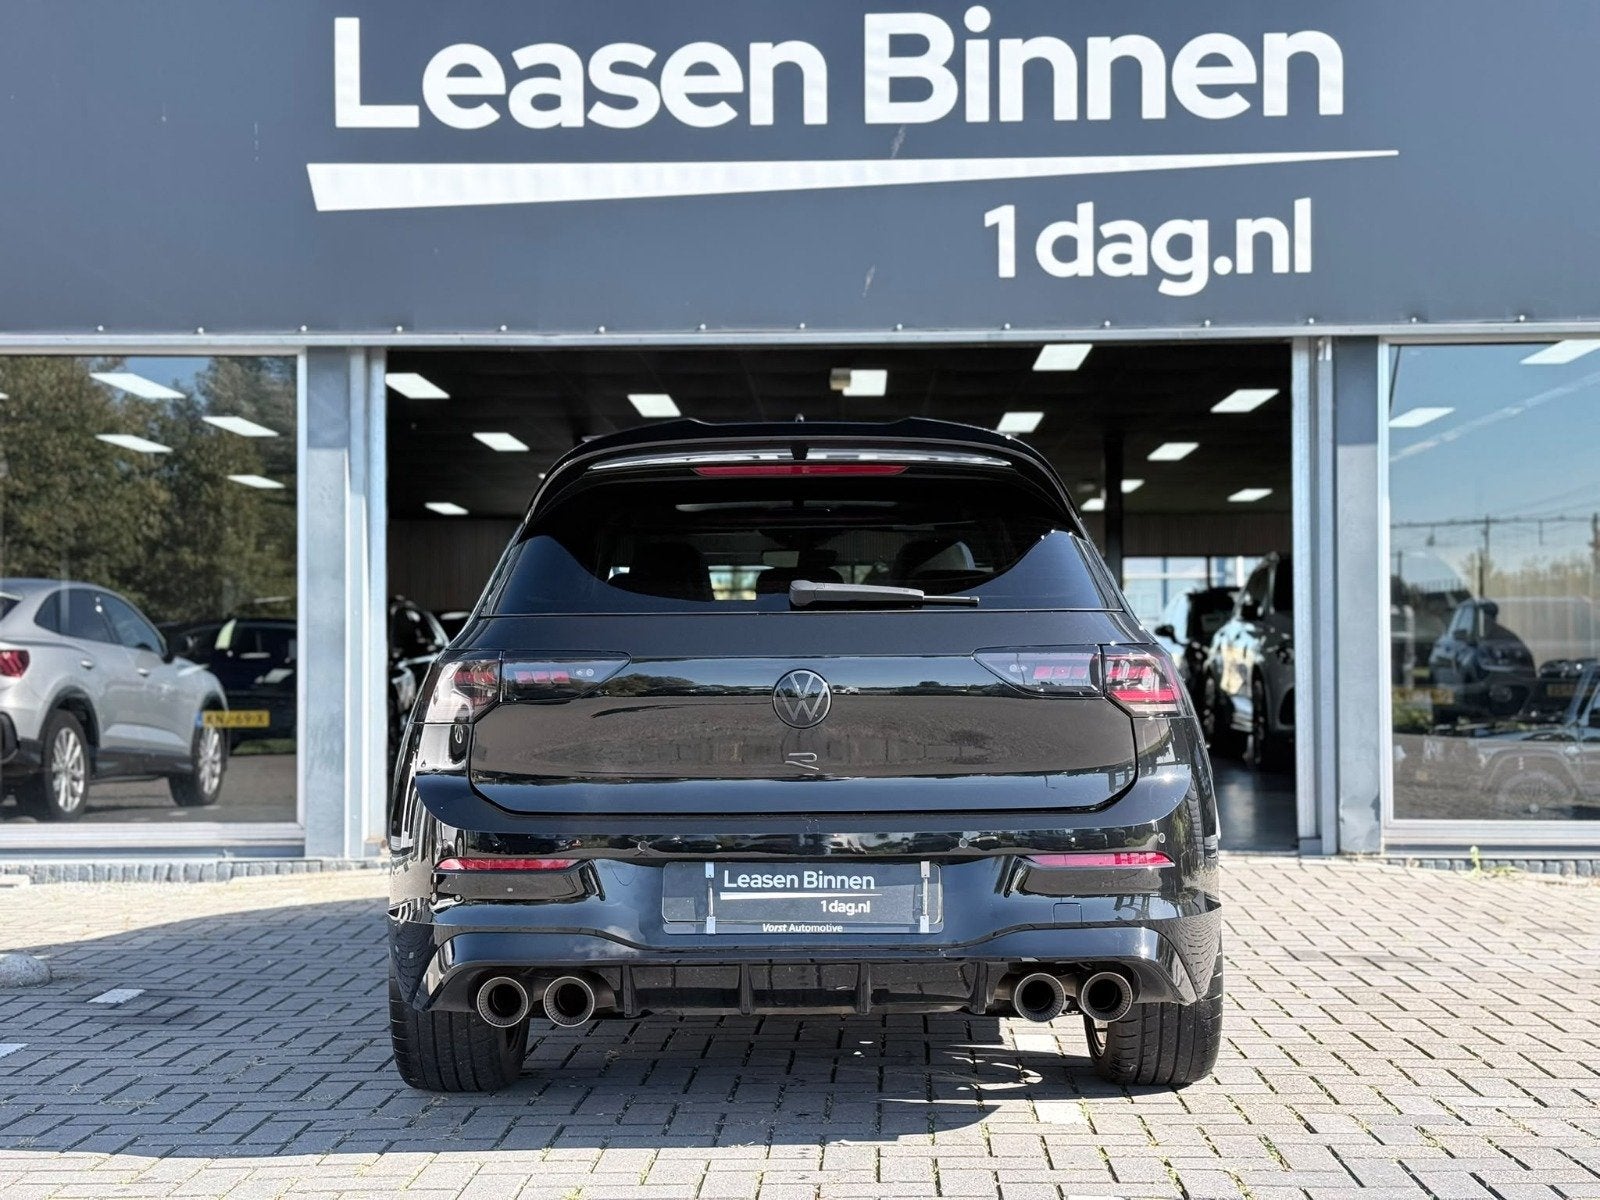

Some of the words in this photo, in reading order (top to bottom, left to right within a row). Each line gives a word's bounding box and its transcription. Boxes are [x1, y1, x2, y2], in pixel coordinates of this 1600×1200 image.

[334, 16, 828, 130] Leasen
[864, 6, 1344, 125] Binnen
[723, 869, 799, 889] Leasen
[803, 870, 876, 891] Binnen
[762, 923, 787, 933] Vorst
[788, 923, 843, 933] Automotive
